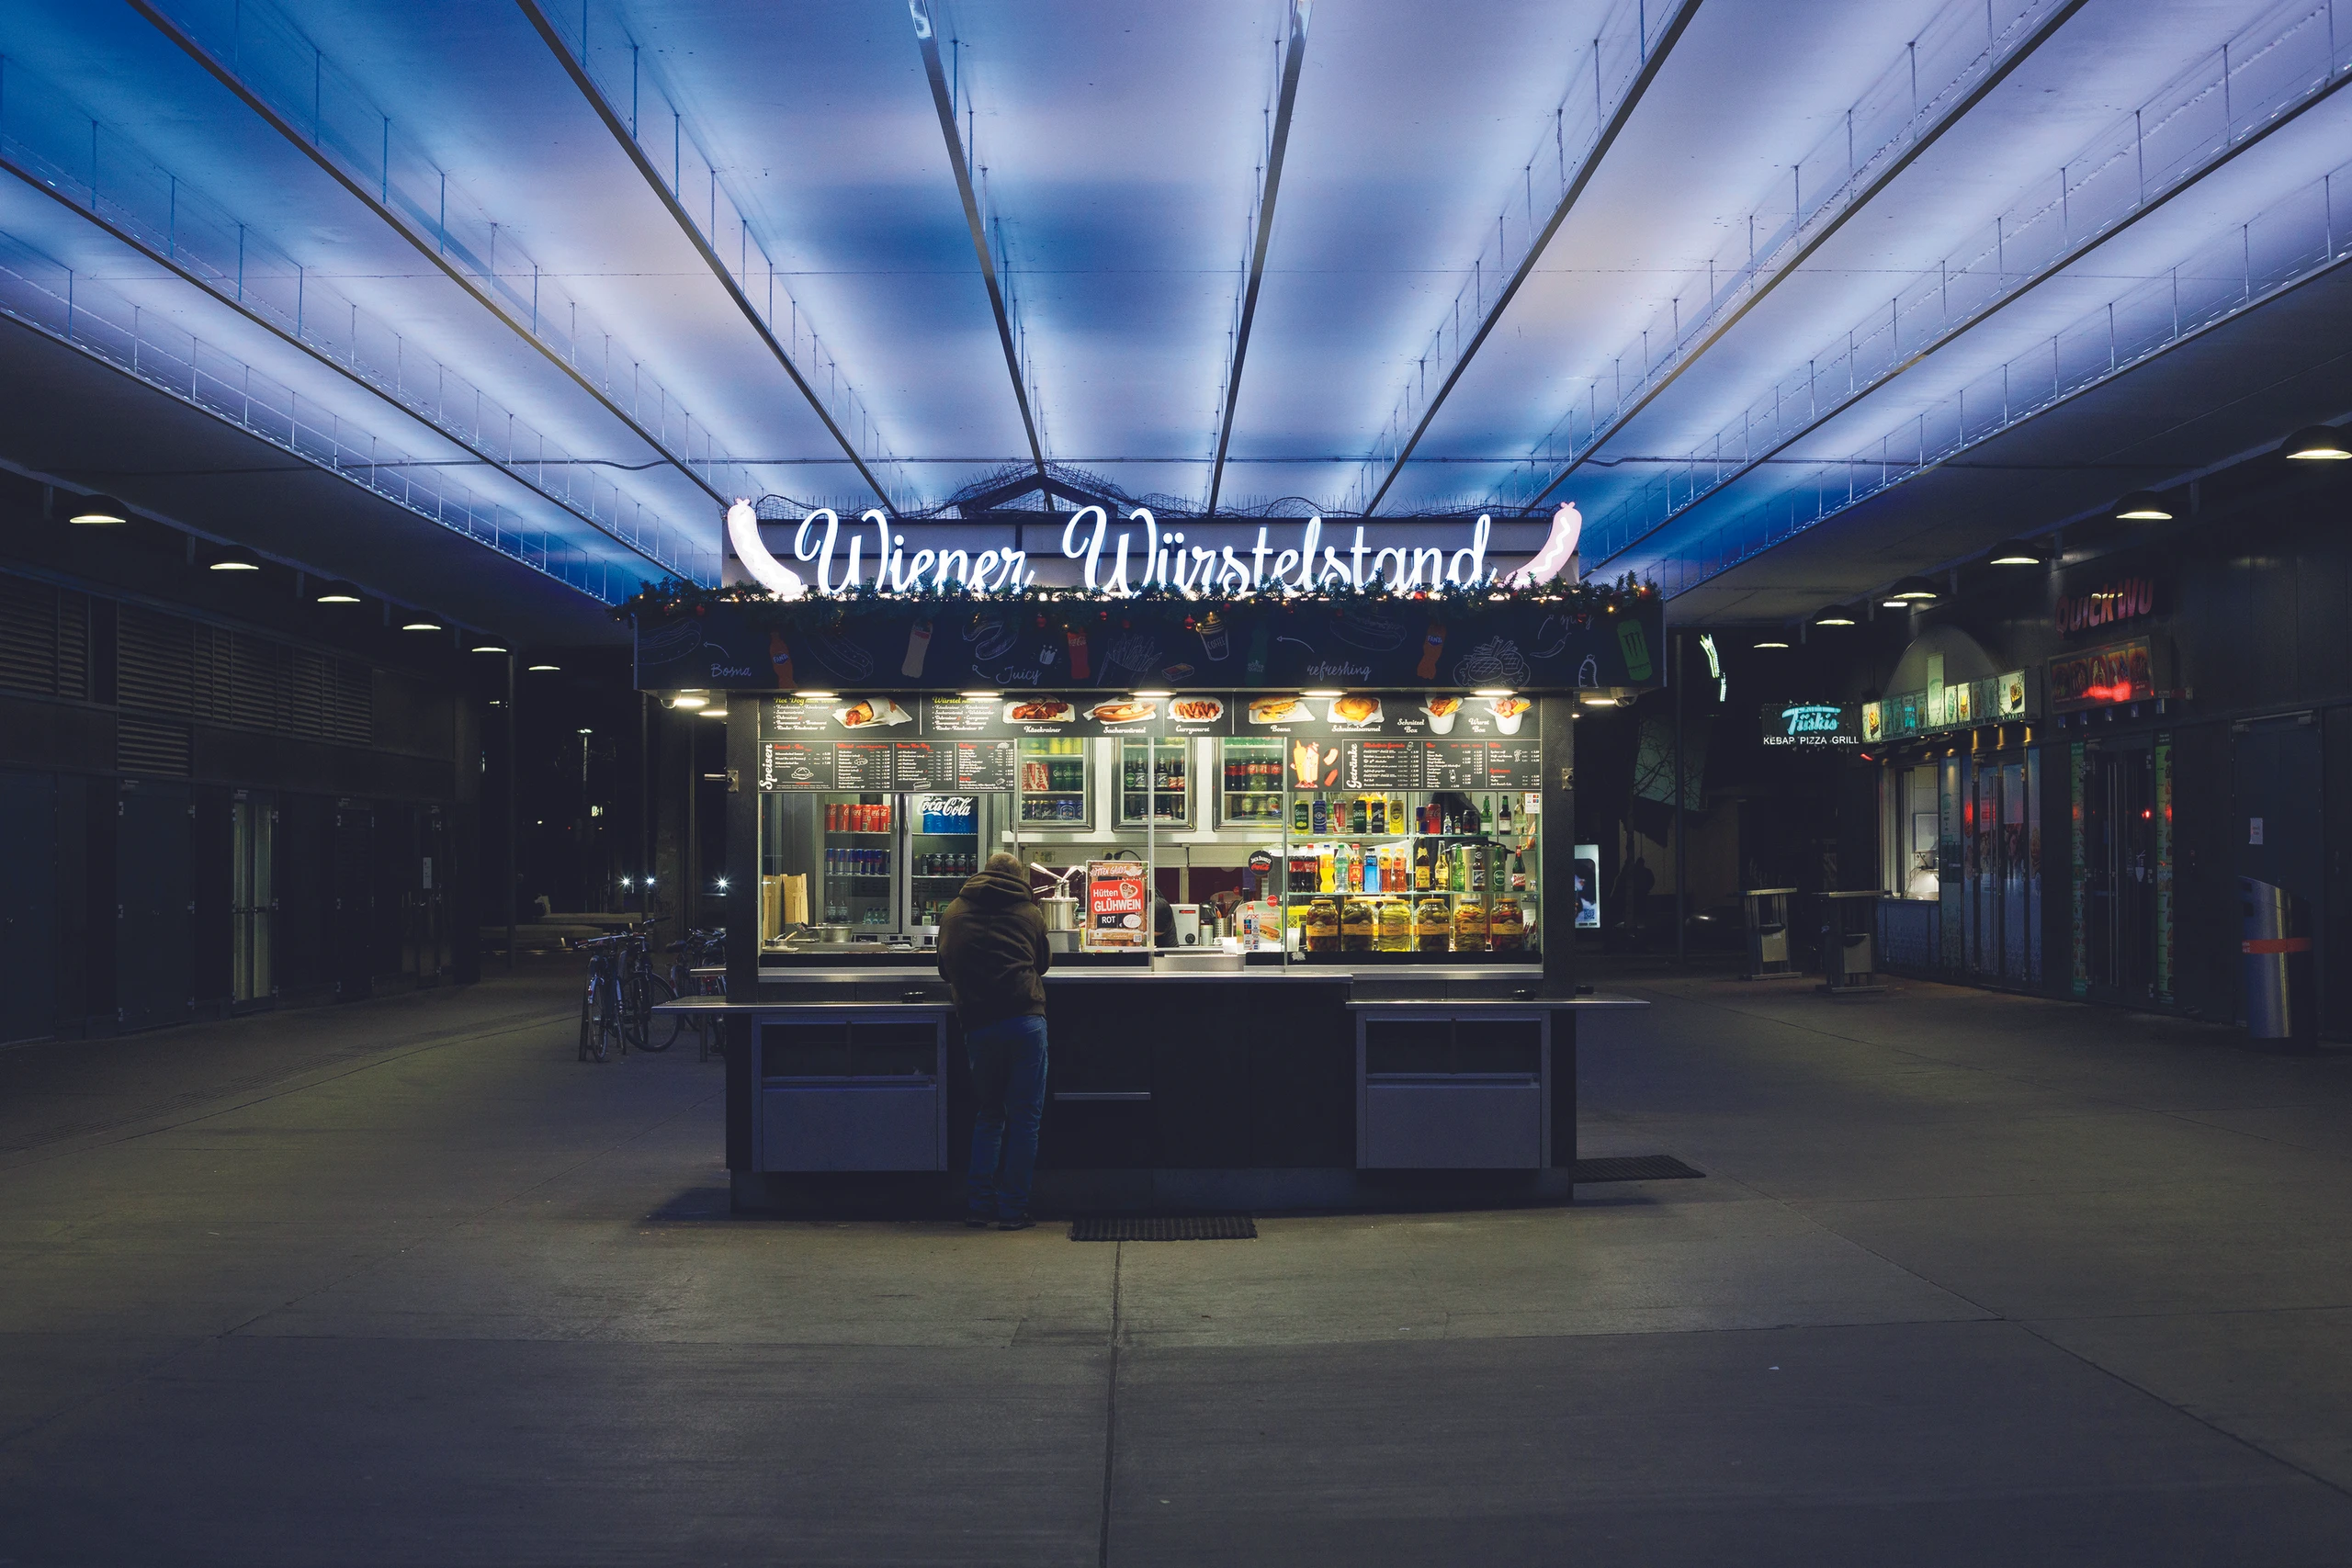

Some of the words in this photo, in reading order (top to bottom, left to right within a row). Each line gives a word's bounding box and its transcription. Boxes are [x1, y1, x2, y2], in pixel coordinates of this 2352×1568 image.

[794, 508, 1035, 595] Wiener
[1062, 505, 1498, 594] Würstelstand
[1206, 636, 1226, 650] COFFEE
[710, 662, 752, 678] Bosna
[996, 666, 1043, 685] Juicy
[1306, 660, 1373, 682] refreshing
[1782, 705, 1841, 735] Türkis
[1023, 726, 1061, 734] Käsekrainer
[1102, 726, 1146, 734] Sacherwürstel
[1175, 726, 1210, 735] Currywurst
[1270, 725, 1292, 733] Bosna
[1331, 724, 1381, 733] Schnitzelsemmel
[1763, 736, 1795, 745] KEBAP
[1800, 736, 1827, 745] PIZZA
[1832, 736, 1860, 744] GRILL
[759, 743, 778, 790] Speisen
[1345, 742, 1363, 789] Getränke
[916, 796, 974, 817] Coca-Cola
[1092, 889, 1118, 897] Hütten
[1094, 897, 1141, 912] GLÜHWEIN
